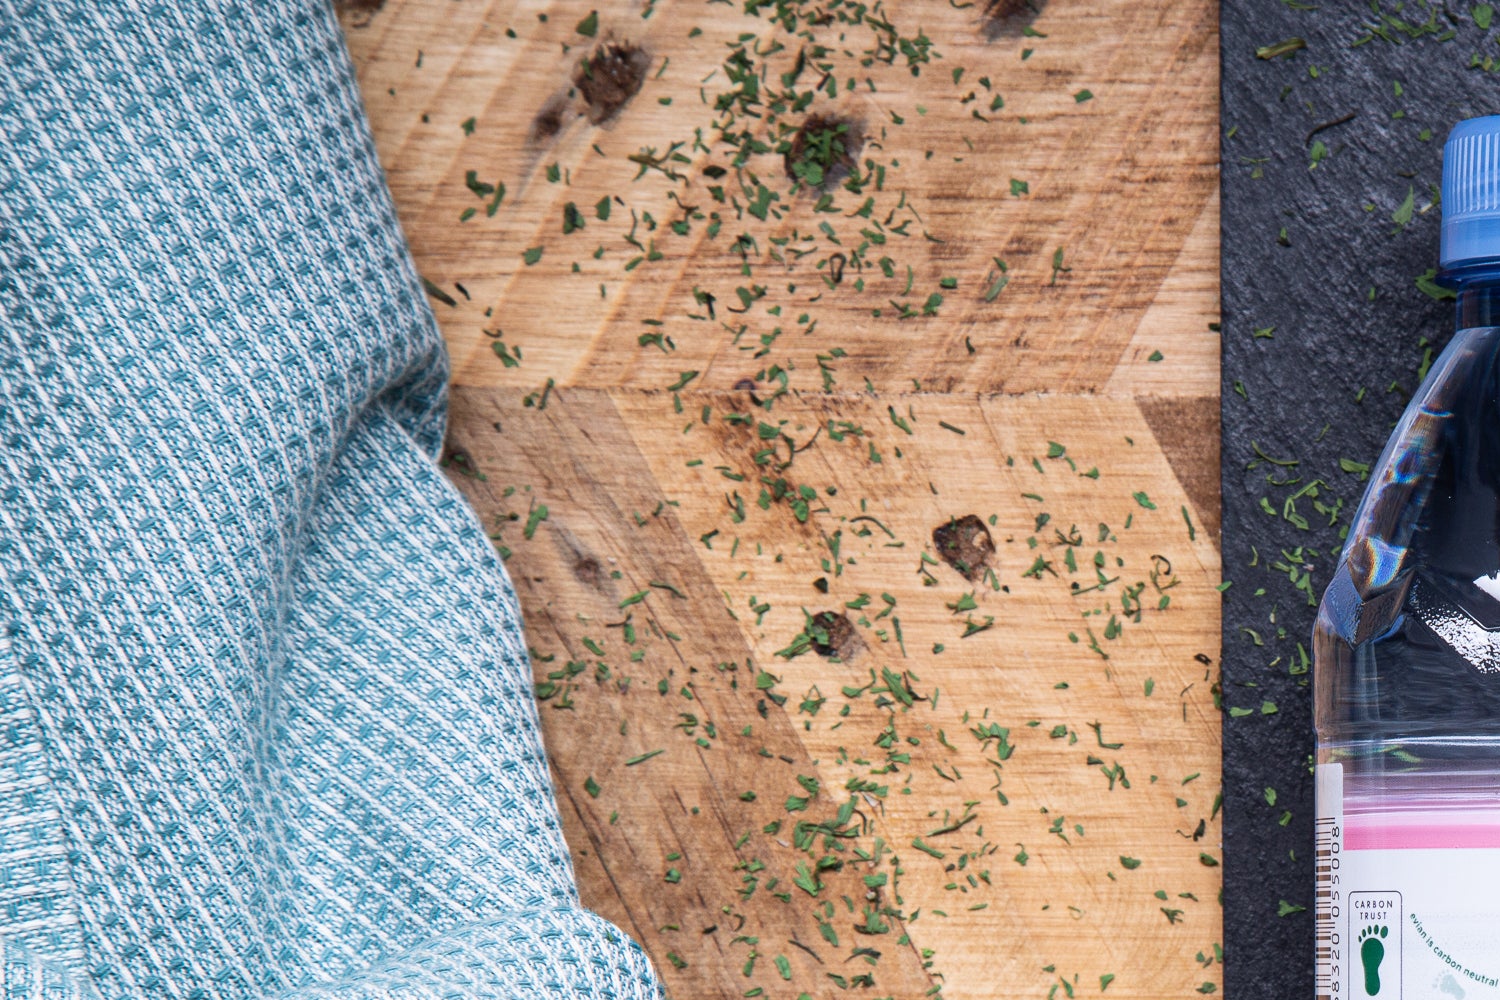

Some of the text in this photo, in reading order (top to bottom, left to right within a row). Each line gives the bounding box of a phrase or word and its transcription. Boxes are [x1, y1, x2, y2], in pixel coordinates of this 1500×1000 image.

[1355, 900, 1393, 909] CARBON
[1360, 911, 1387, 920] TRUST
[1410, 913, 1499, 987] evian is carbon neutral
